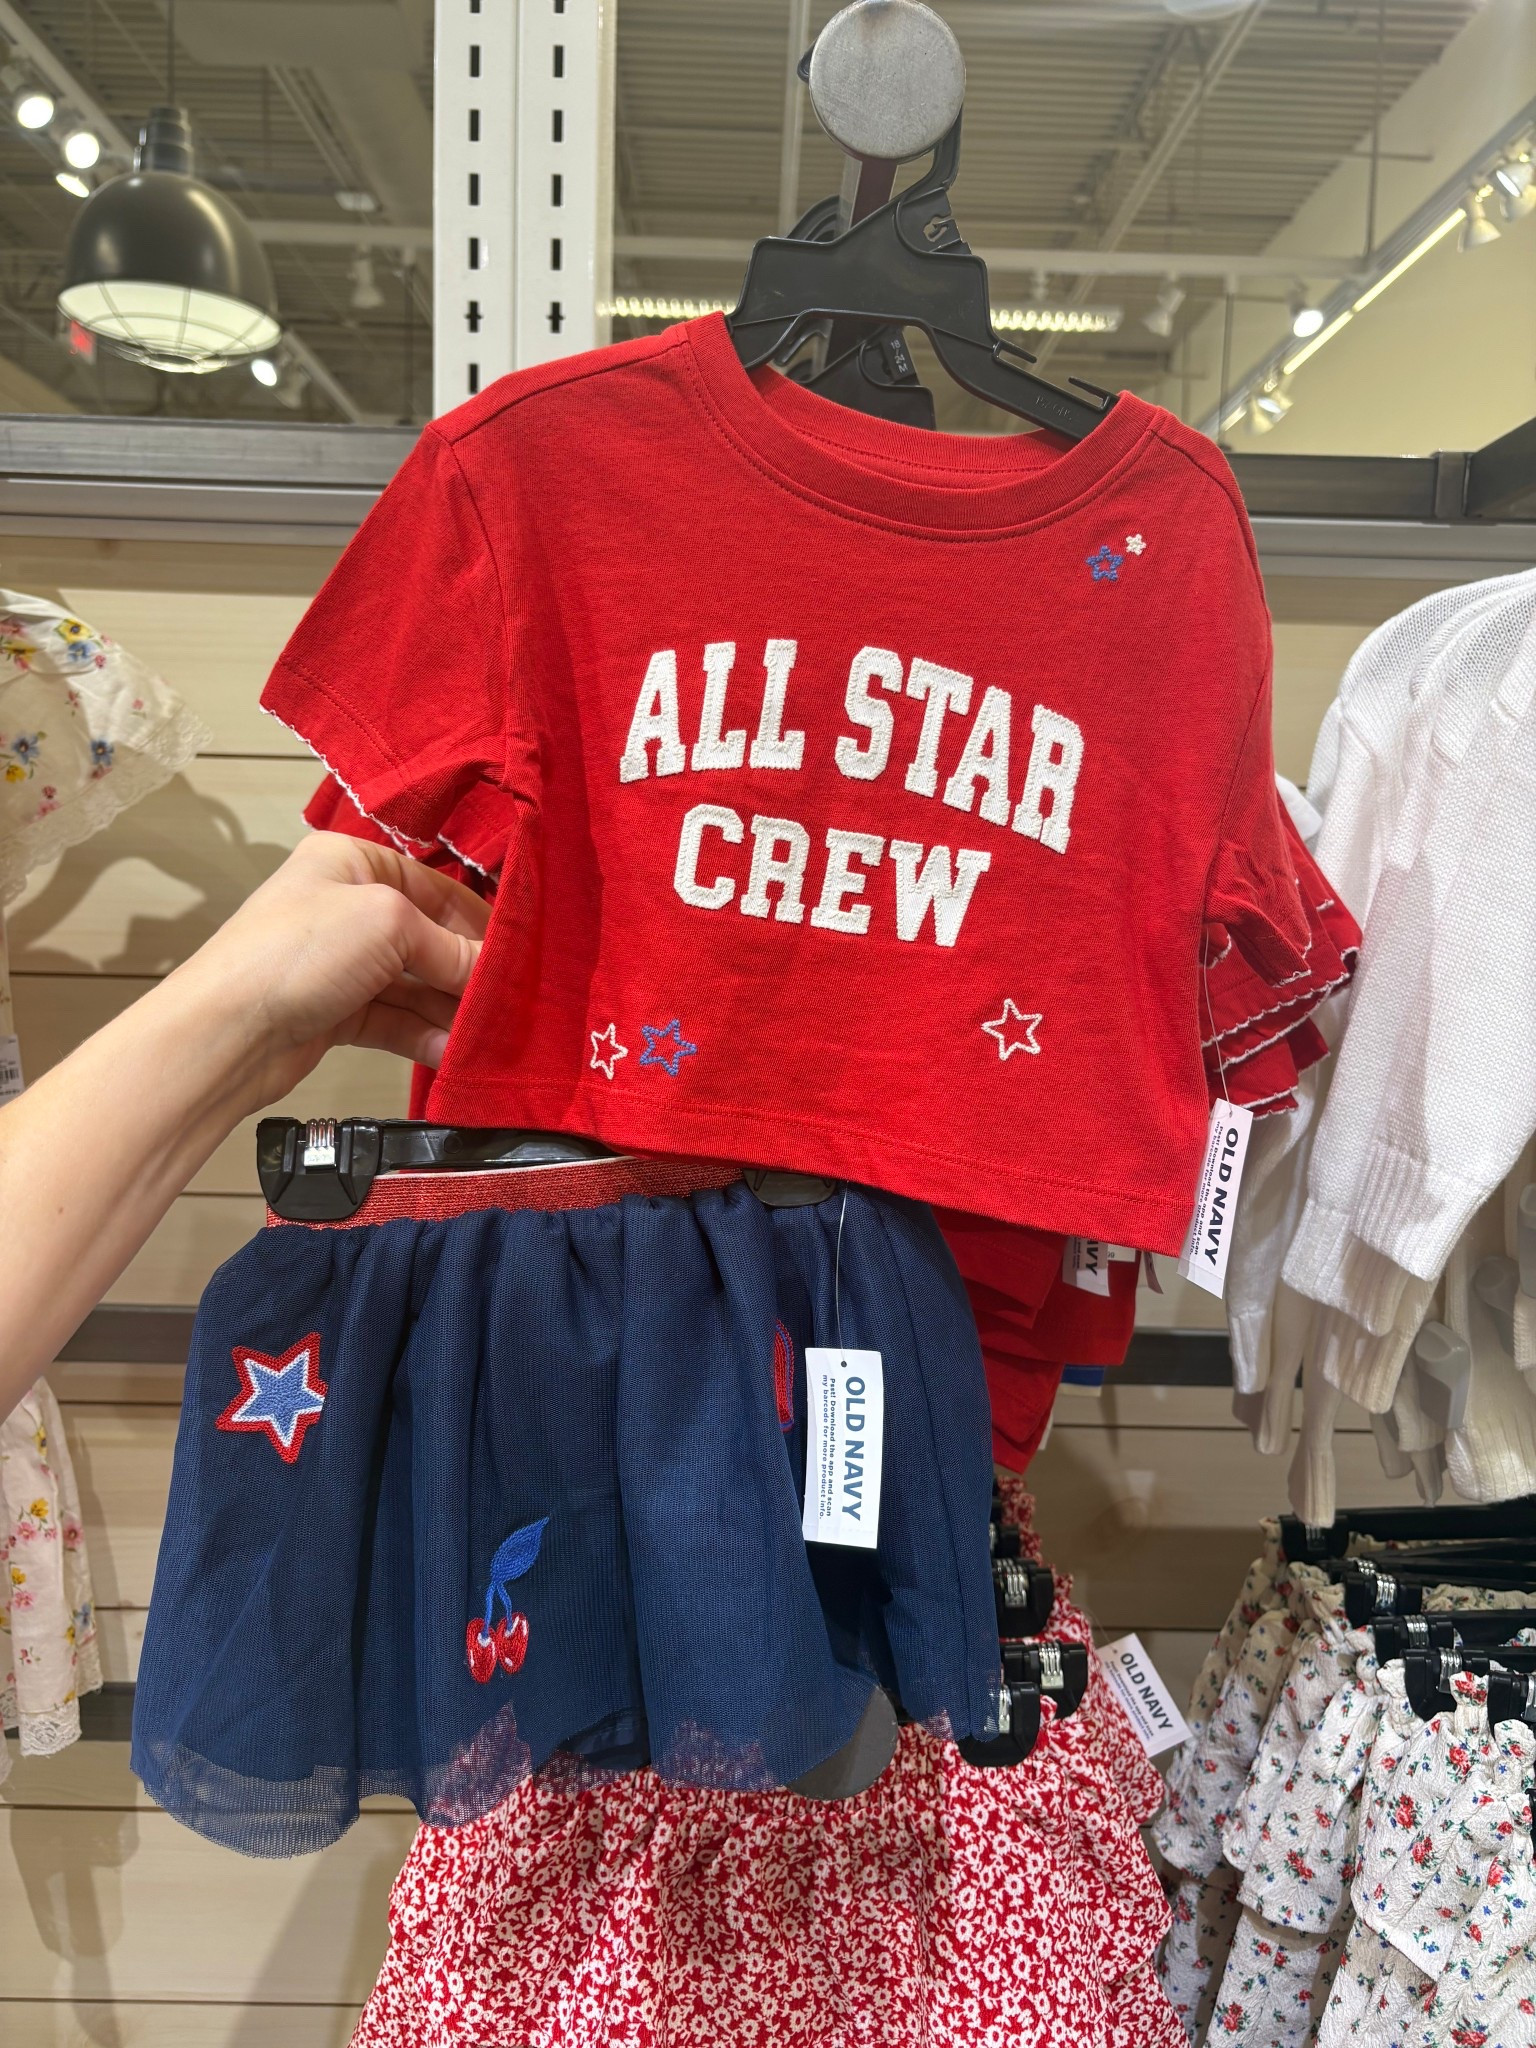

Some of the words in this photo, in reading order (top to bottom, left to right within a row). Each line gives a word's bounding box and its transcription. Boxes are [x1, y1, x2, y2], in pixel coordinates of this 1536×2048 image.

[619, 638, 805, 784] ALL
[834, 645, 1085, 855] STAR
[673, 803, 991, 948] CREW
[1206, 1148, 1218, 1187] Download
[1218, 1127, 1239, 1182] OLD
[1204, 1187, 1228, 1267] NAVY
[822, 1374, 828, 1387] my
[845, 1376, 866, 1432] OLD
[842, 1440, 865, 1521] NAVY
[1120, 1652, 1145, 1685] OLD
[1138, 1685, 1174, 1730] NAVY
